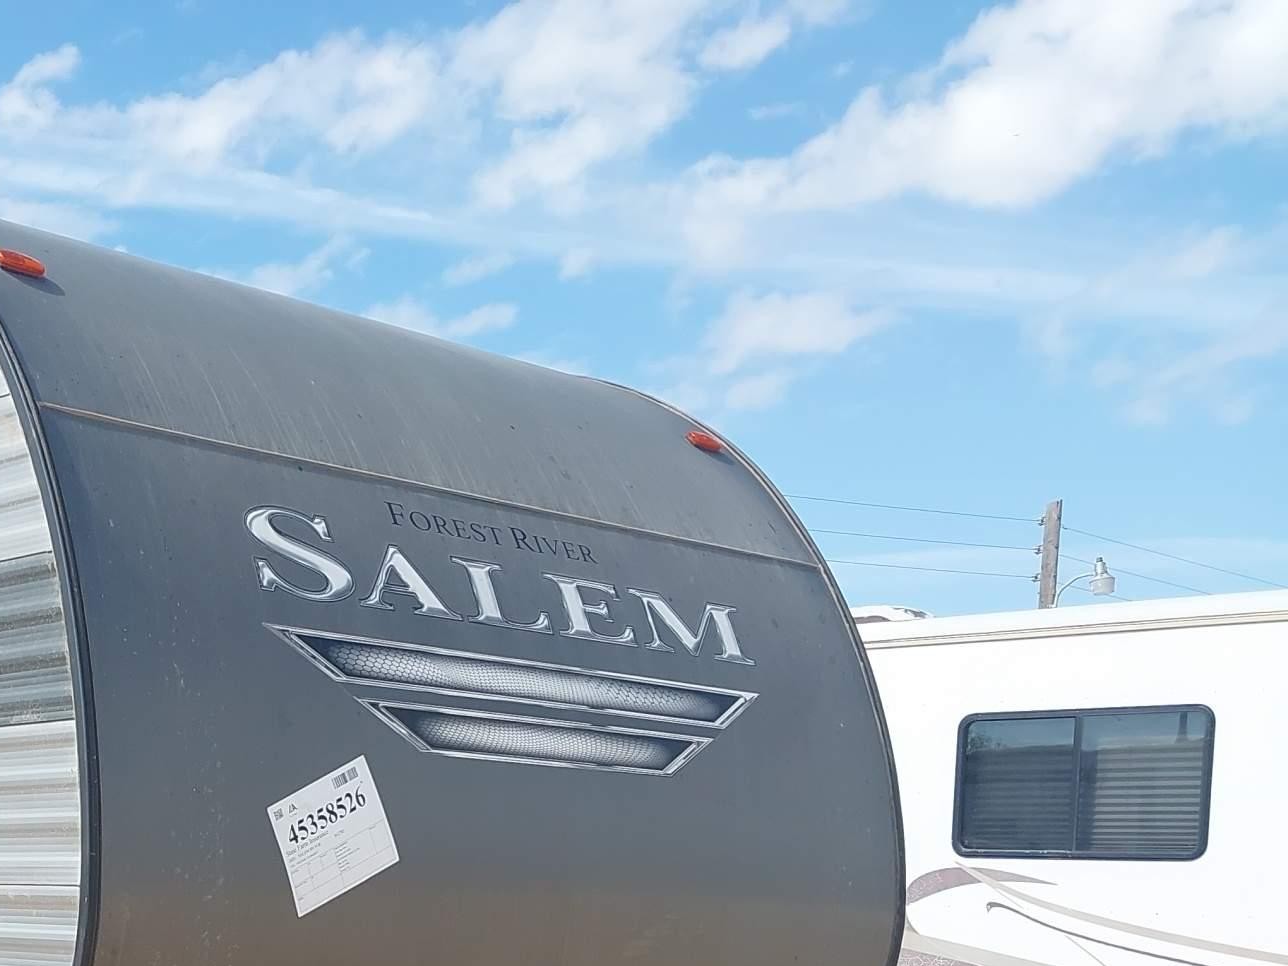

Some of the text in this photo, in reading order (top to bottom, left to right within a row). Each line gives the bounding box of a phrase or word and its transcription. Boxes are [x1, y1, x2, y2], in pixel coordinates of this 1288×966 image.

[384, 501, 599, 564] FOREST RIVER
[243, 504, 757, 666] SALEM
[288, 785, 366, 844] 45358526
